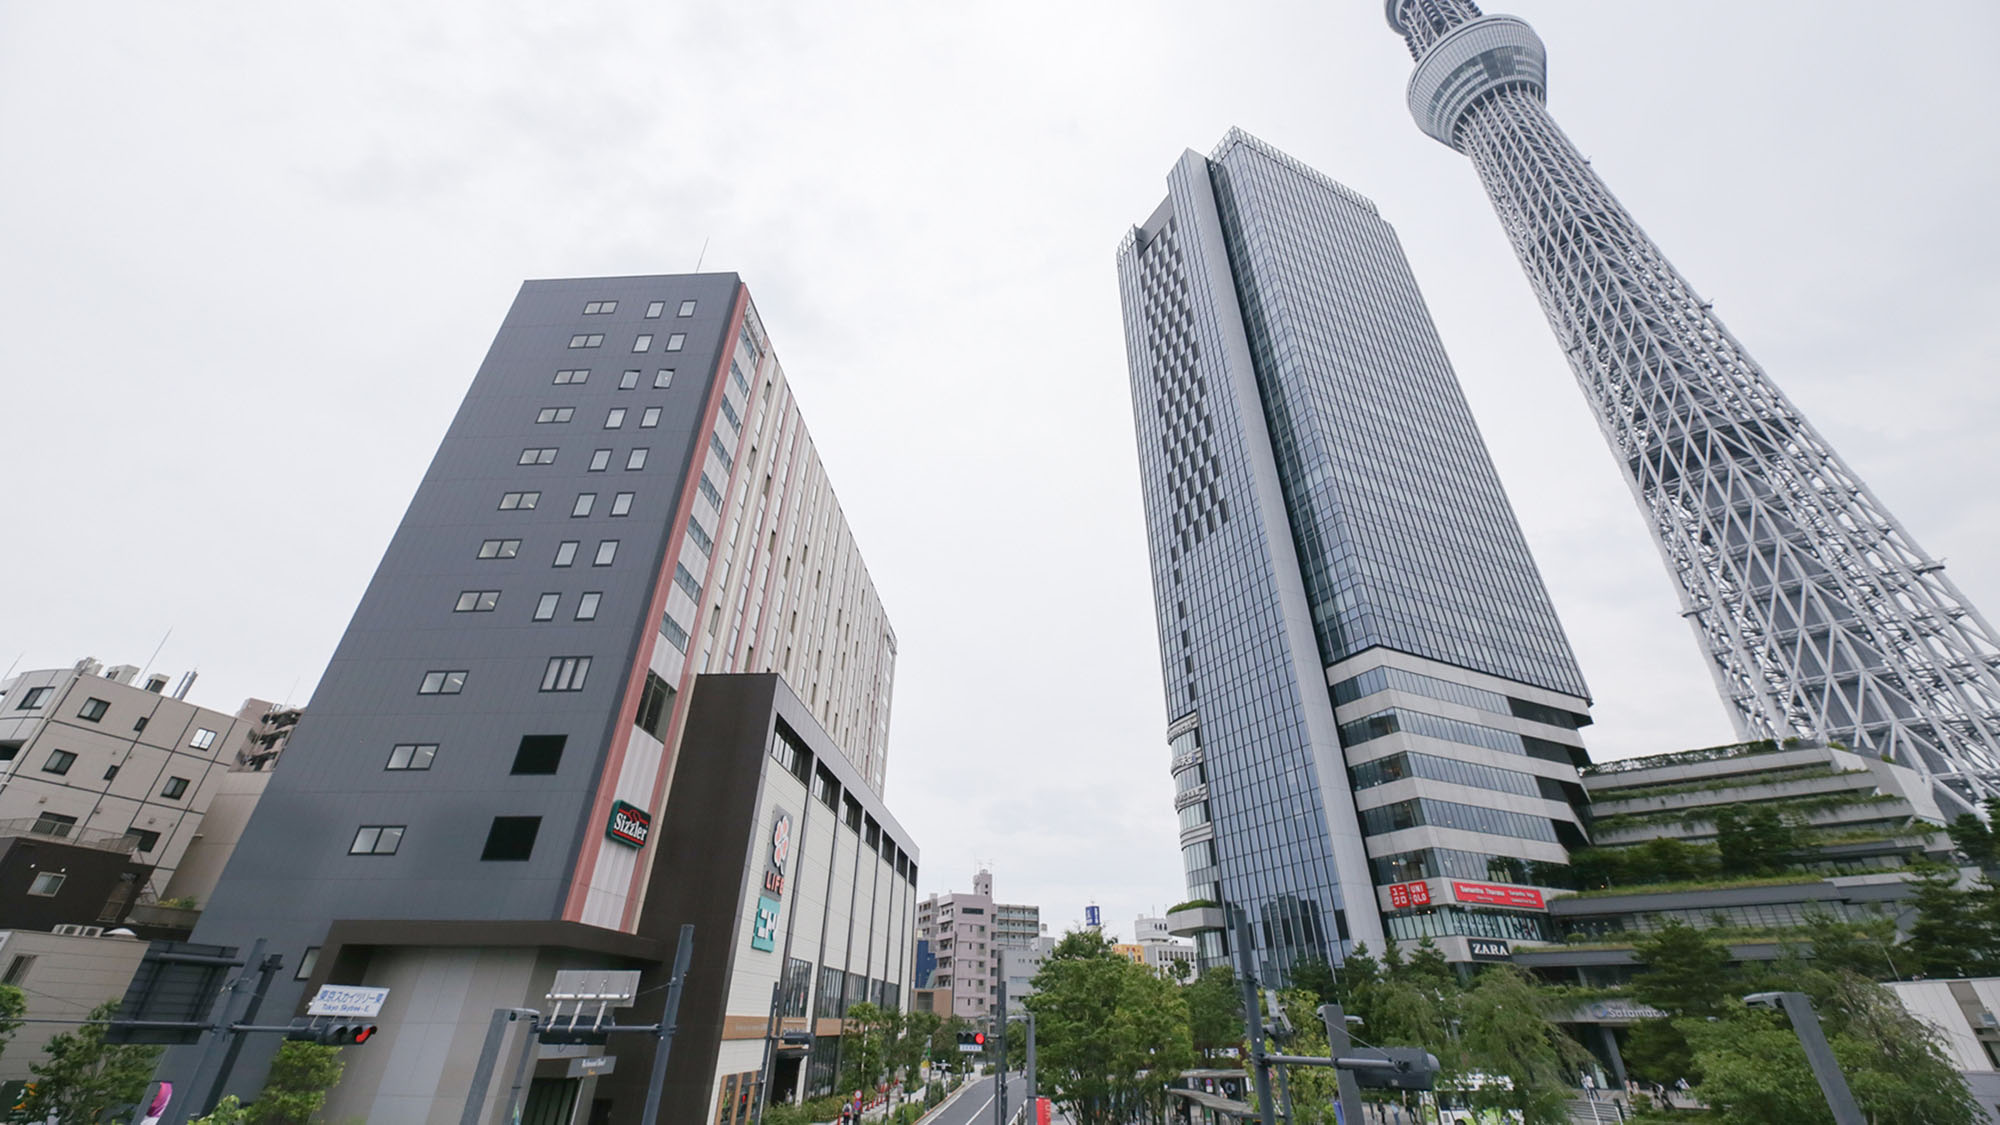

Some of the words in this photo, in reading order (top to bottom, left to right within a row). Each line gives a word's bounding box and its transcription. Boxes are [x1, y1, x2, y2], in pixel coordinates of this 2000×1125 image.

[614, 812, 648, 841] Sizzler
[765, 870, 785, 896] LIFE
[1410, 884, 1424, 893] UNI
[1413, 893, 1427, 903] QLO
[1472, 943, 1510, 956] ZARA
